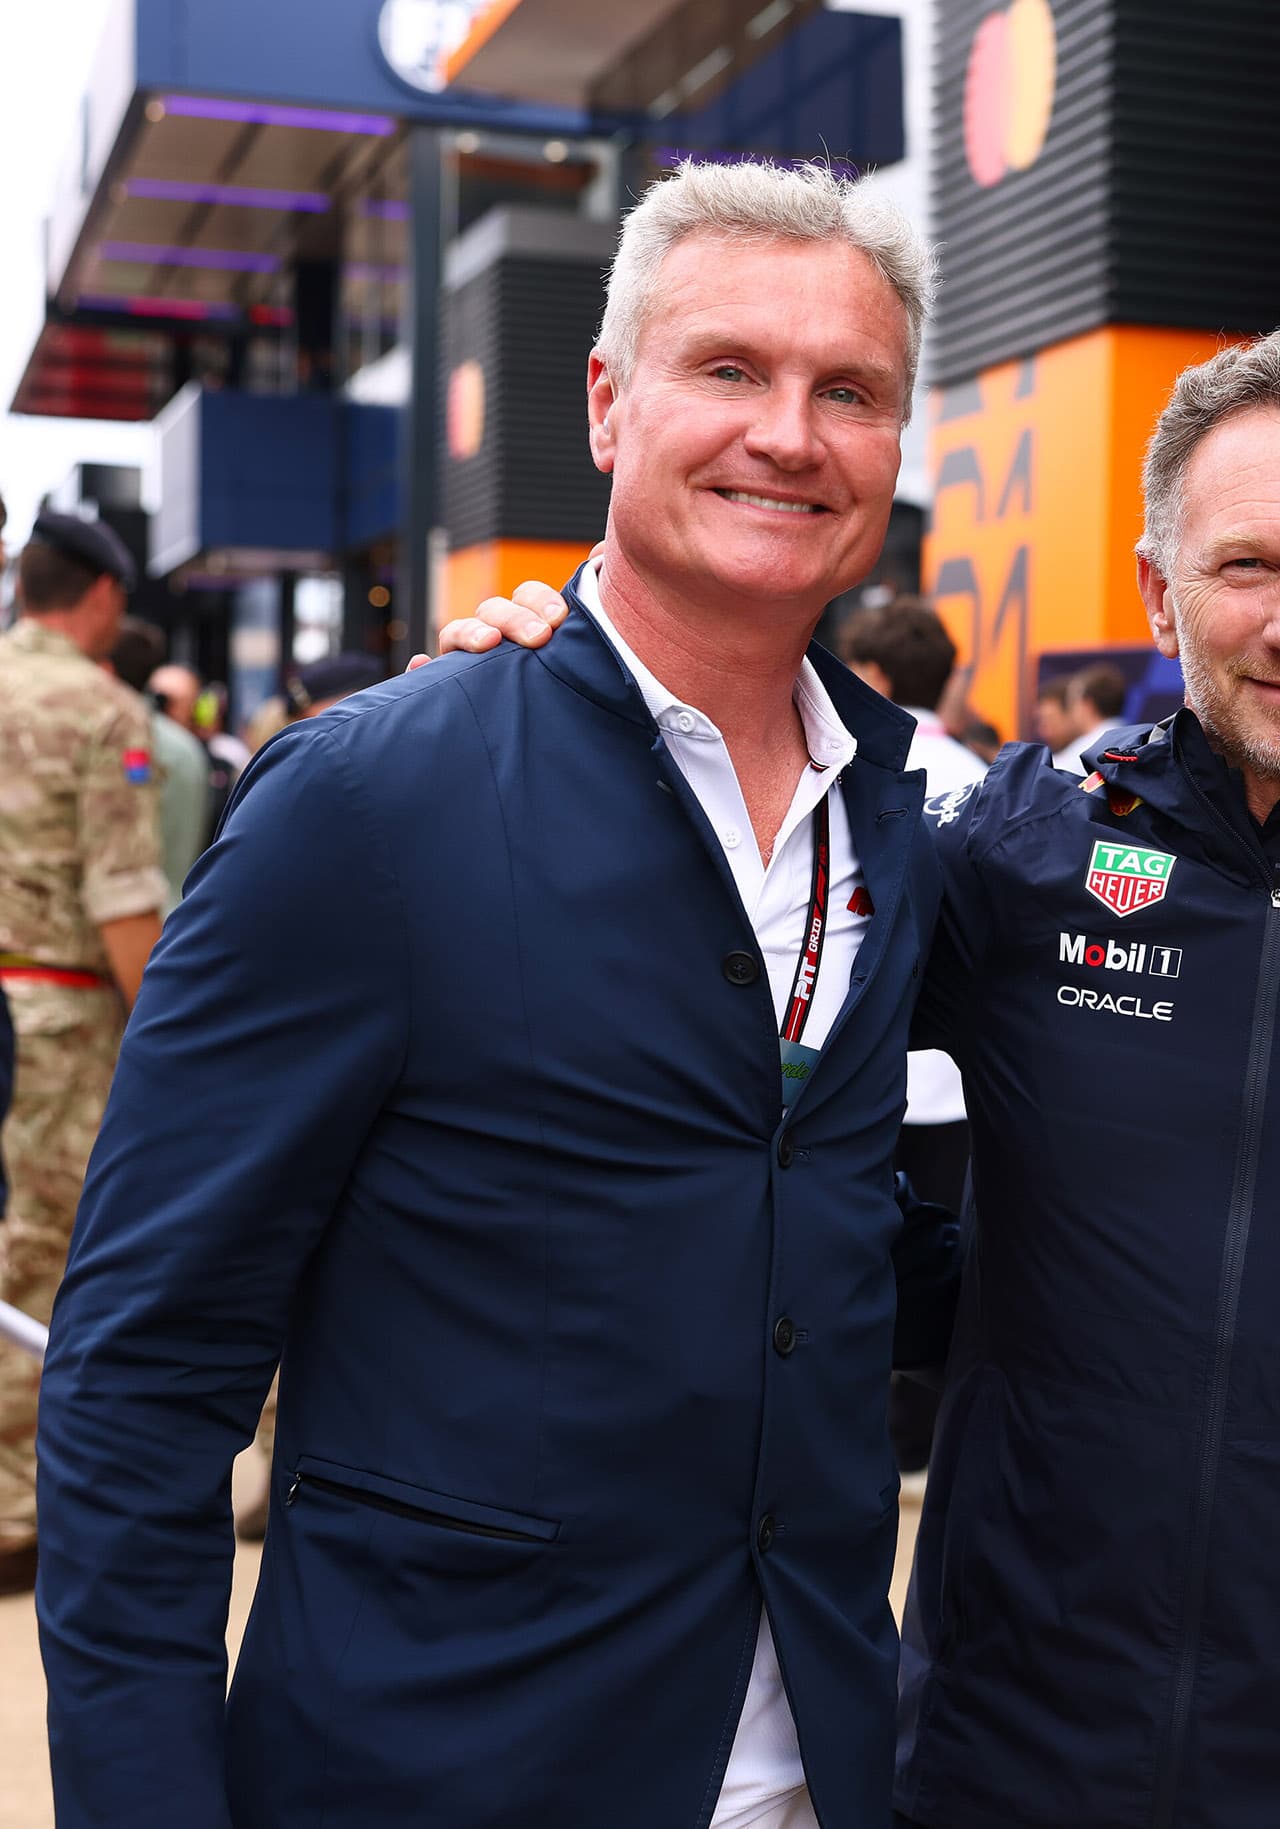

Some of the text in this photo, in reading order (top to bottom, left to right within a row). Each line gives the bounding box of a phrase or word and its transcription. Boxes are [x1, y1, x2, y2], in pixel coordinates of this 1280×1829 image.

[1101, 847, 1166, 876] TAG
[1092, 873, 1162, 911] HEUER
[793, 918, 822, 1001] PIT GRID
[1059, 932, 1146, 974] Mobil
[1057, 985, 1174, 1021] ORACLE
